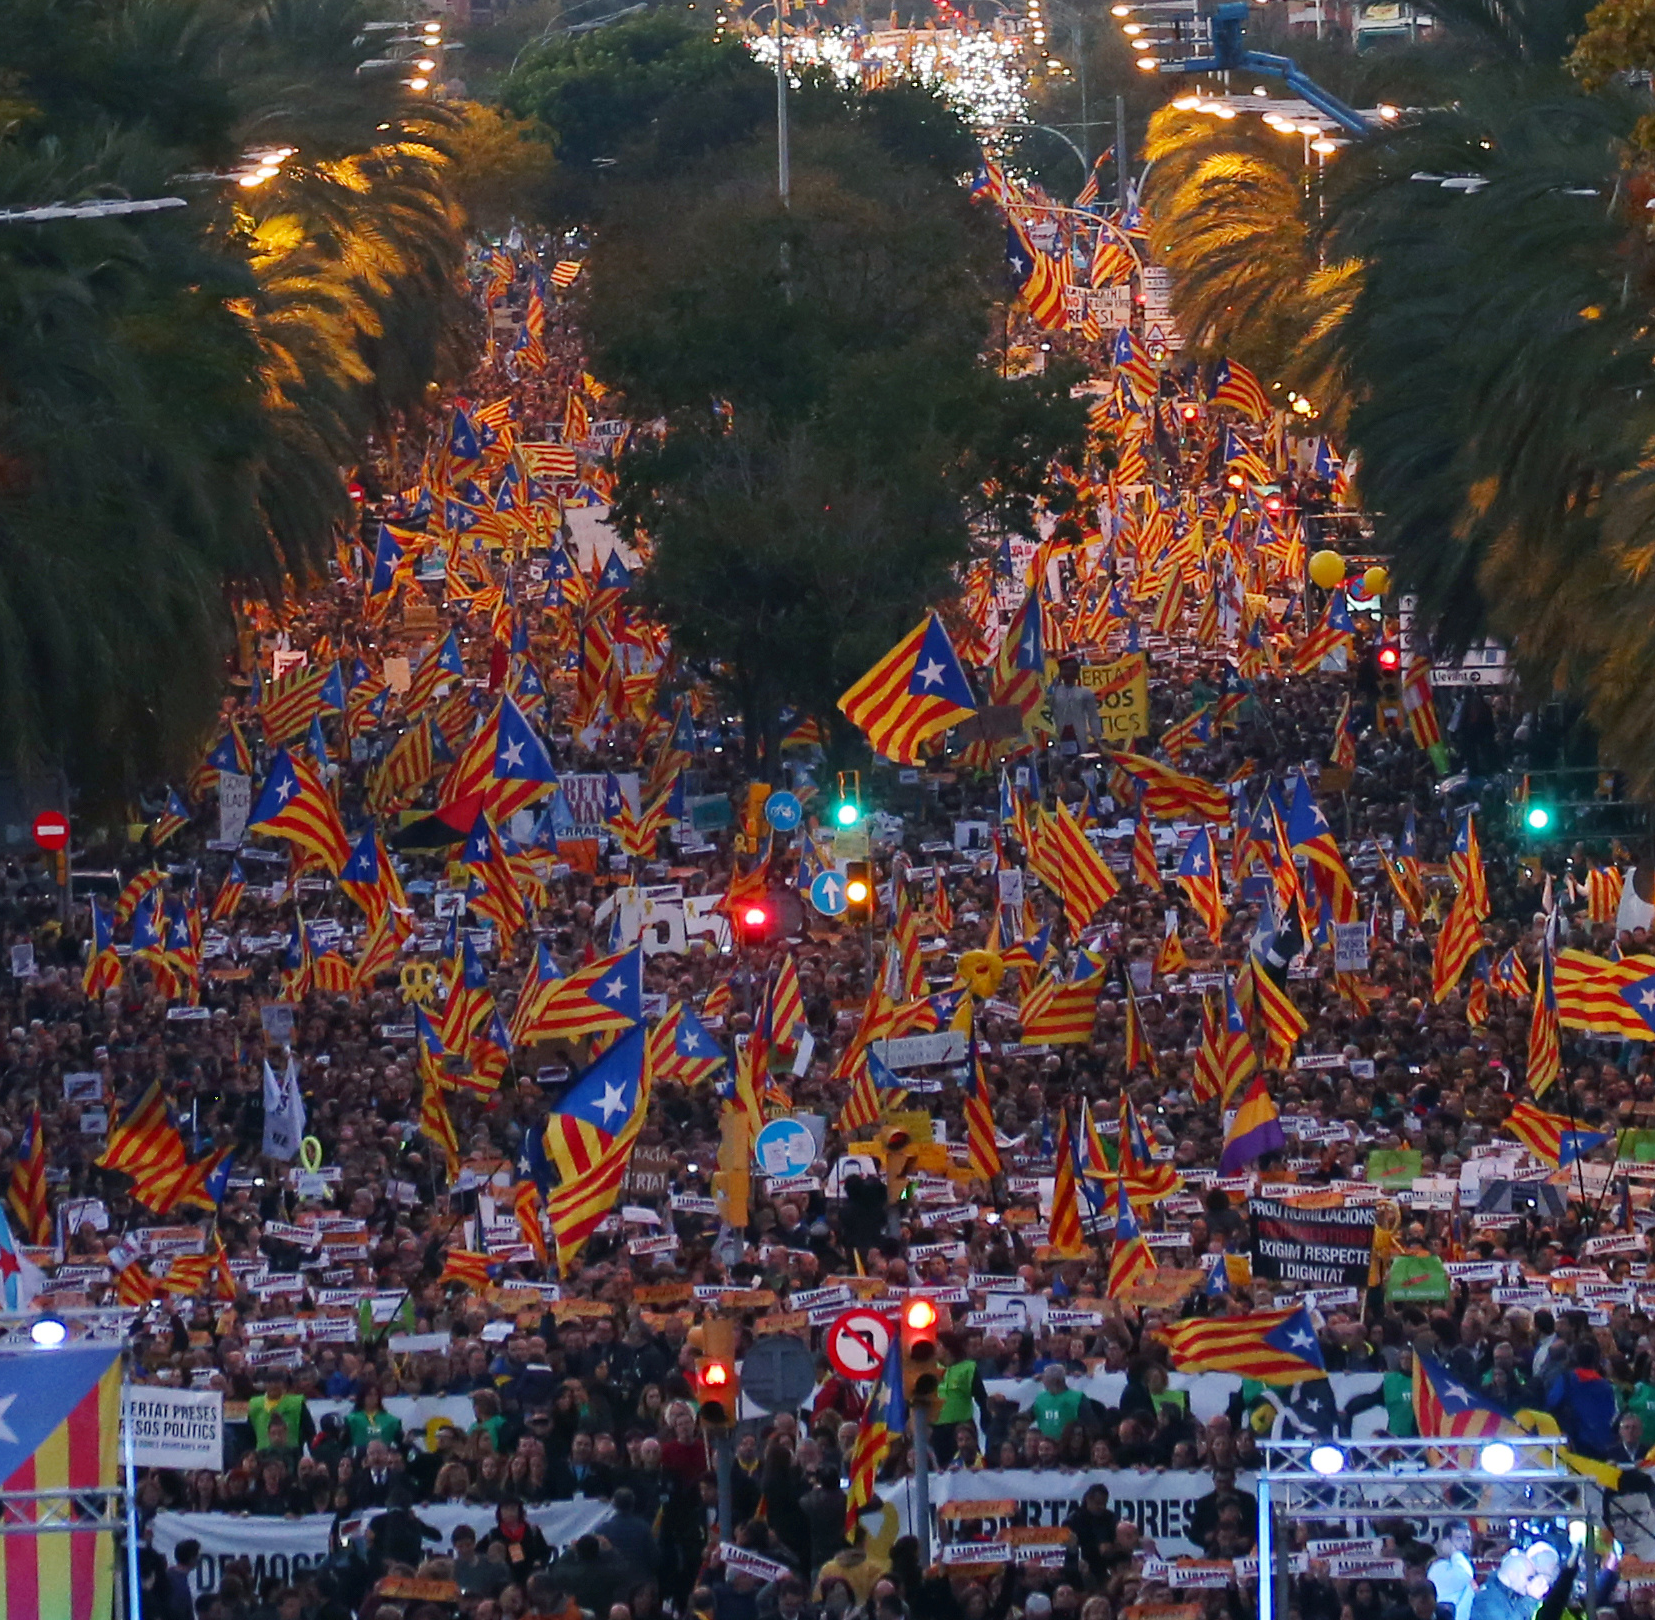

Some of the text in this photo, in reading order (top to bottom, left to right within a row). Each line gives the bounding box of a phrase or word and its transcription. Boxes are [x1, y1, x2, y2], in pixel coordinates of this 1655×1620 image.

[1249, 1200, 1282, 1219] PROU
[1260, 1239, 1371, 1267] EXIGIM RESPECTE
[1280, 1262, 1345, 1284] I DIGNITAT
[173, 1404, 217, 1422] PRESES
[164, 1421, 216, 1440] POLÍTICS
